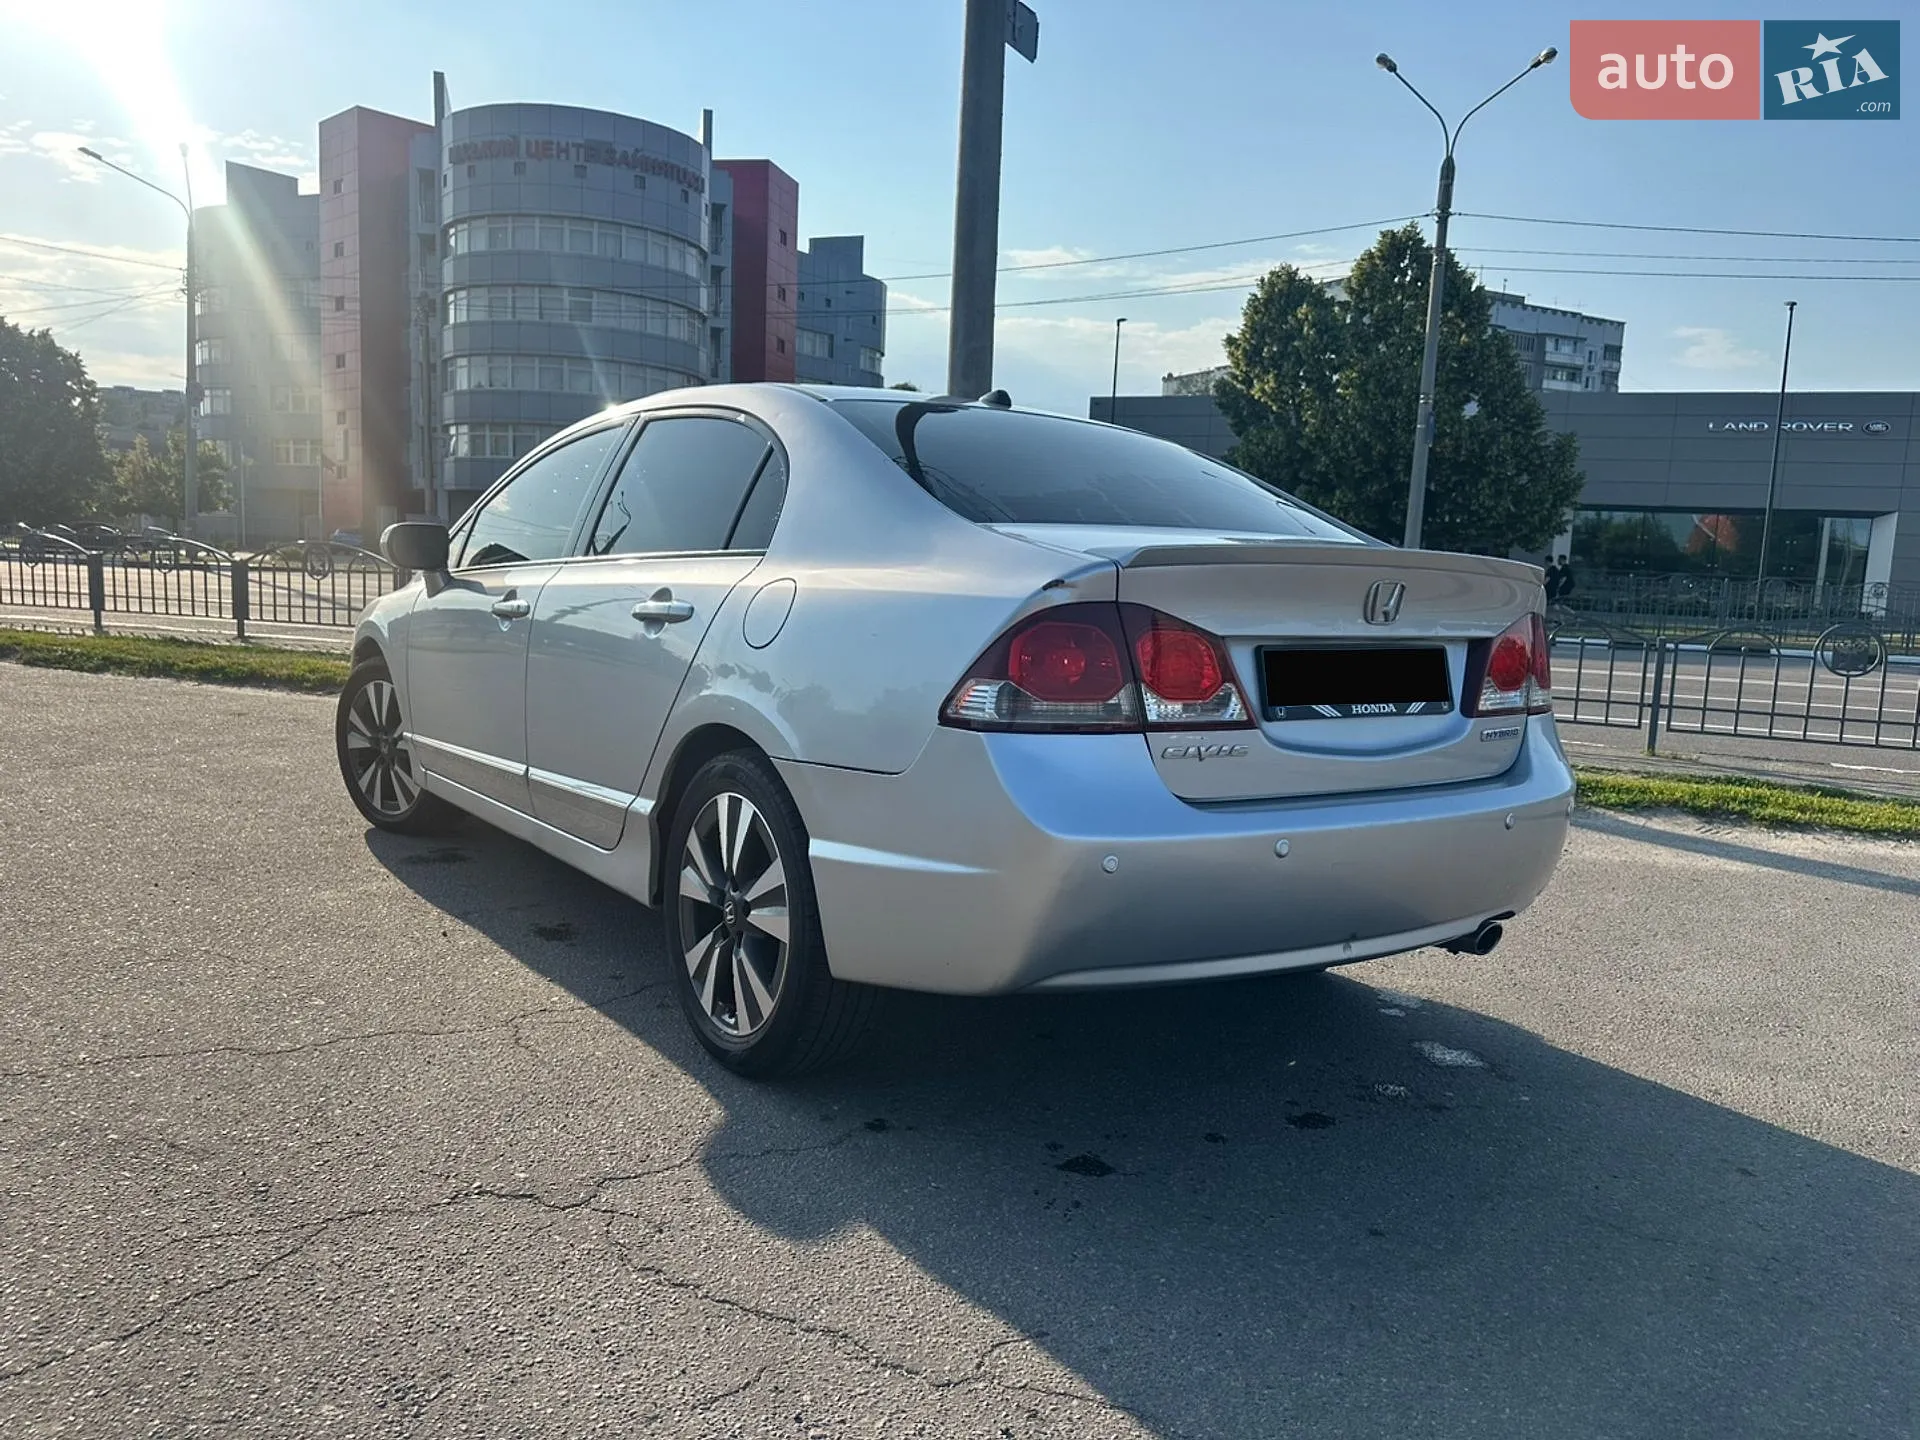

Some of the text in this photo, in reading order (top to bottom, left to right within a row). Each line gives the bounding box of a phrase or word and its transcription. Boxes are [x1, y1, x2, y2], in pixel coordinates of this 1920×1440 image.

[1708, 422, 1853, 432] LAND ROVER
[1352, 703, 1397, 715] HONDA
[1485, 728, 1519, 739] HYBRID
[1161, 744, 1249, 762] CIVIC
